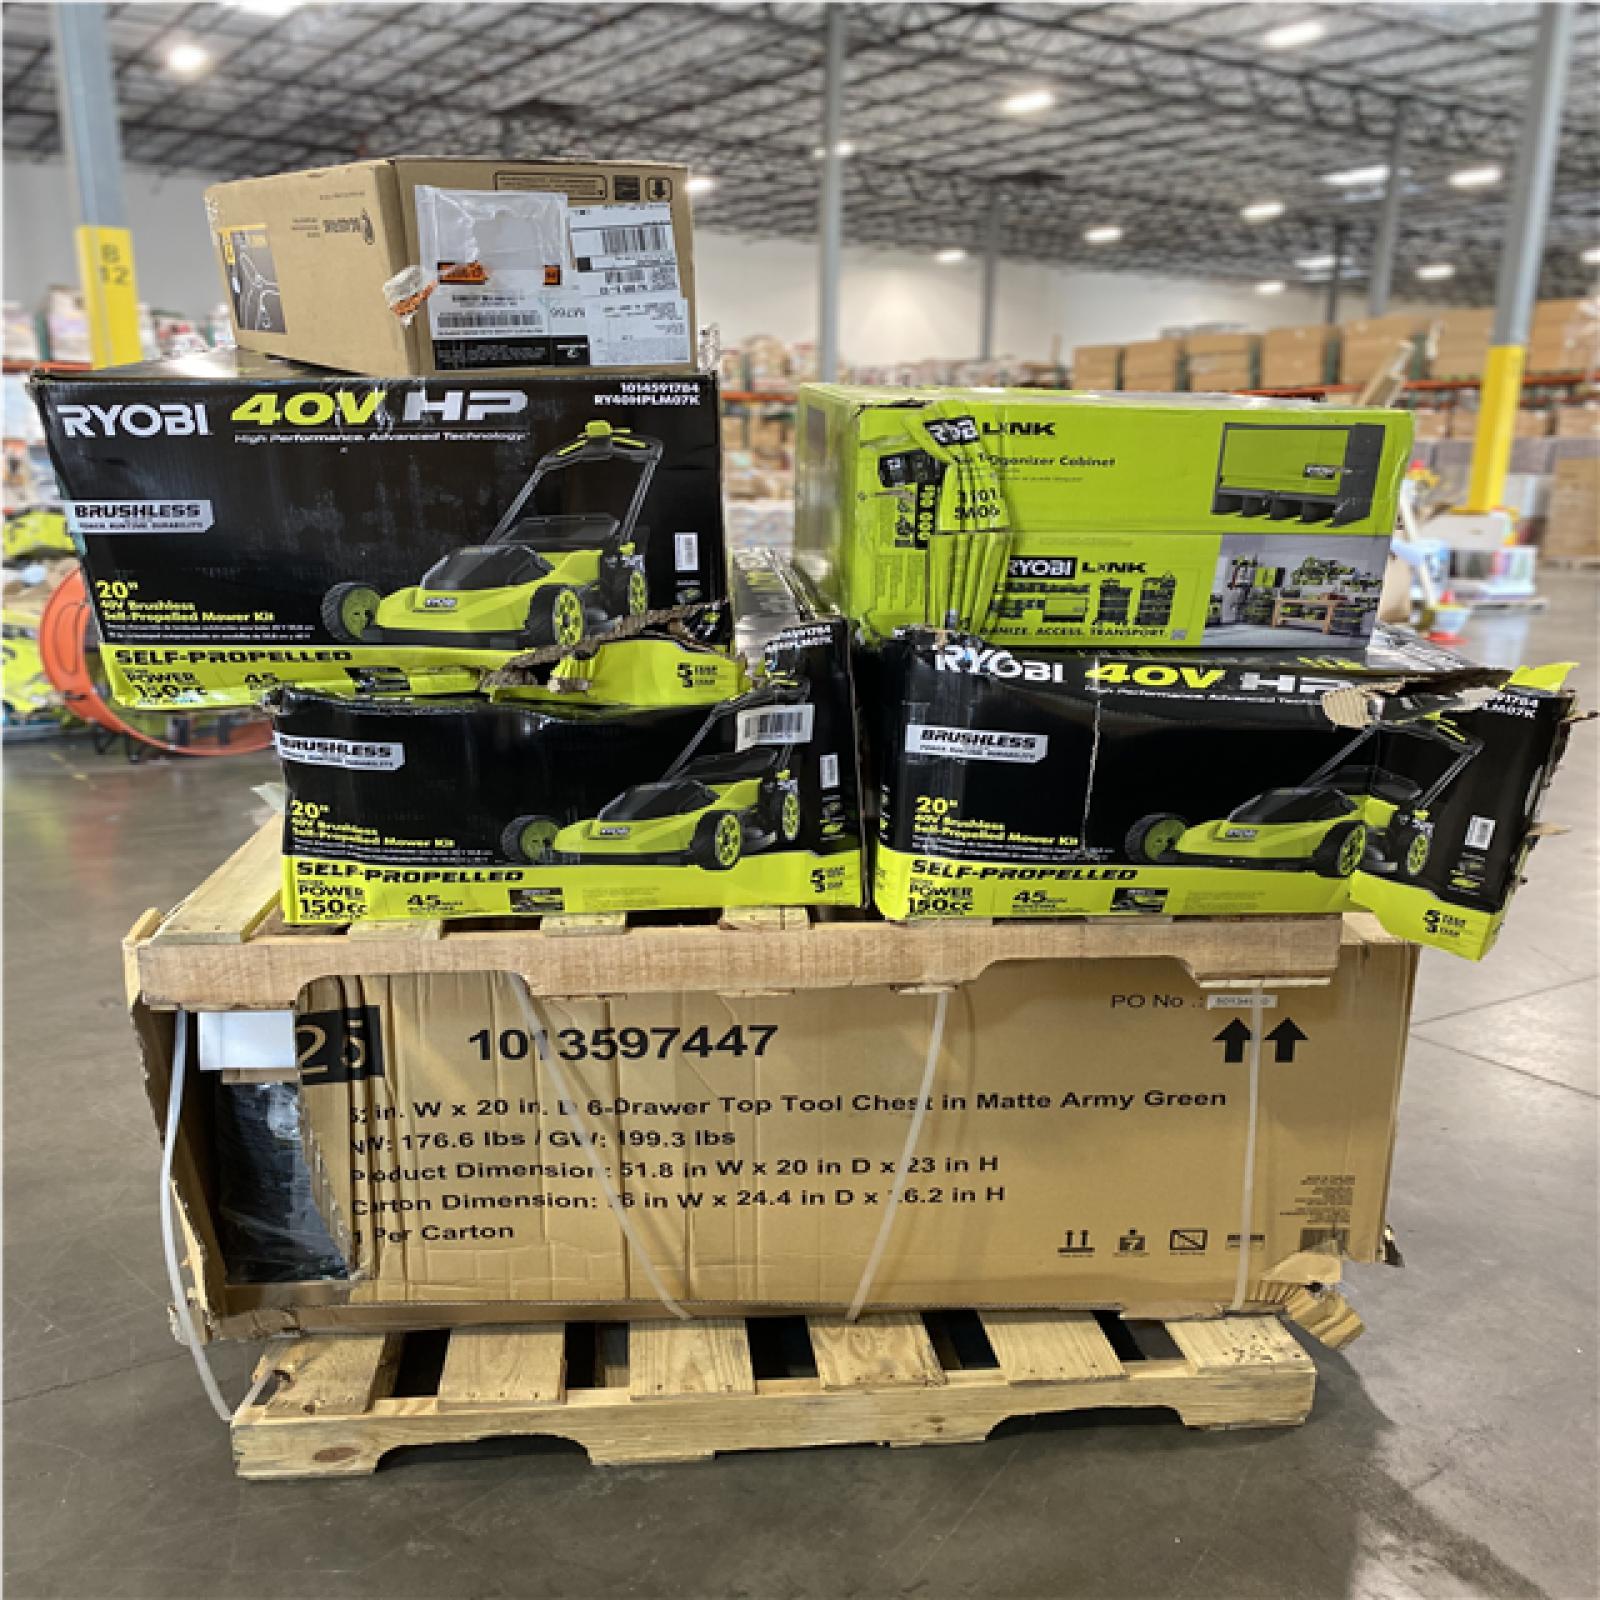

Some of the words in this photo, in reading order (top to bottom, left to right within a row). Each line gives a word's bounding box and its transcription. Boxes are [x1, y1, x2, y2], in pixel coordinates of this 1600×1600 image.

[100, 265, 129, 285] 12
[57, 403, 210, 437] RYOBI
[230, 391, 386, 427] 40V
[403, 389, 529, 421] HP
[1059, 454, 1117, 466] Cabinet
[74, 504, 200, 518] BRUSHLESS
[96, 580, 139, 599] 20"
[115, 650, 353, 665] SELF-PROPELLED
[934, 645, 1065, 683] RYOBI
[1085, 663, 1226, 689] 40V
[921, 729, 1036, 748] BRUSHLESS
[290, 799, 330, 818] 20"
[915, 796, 958, 815] 20"
[297, 861, 525, 884] SELF-PROPELLED
[911, 859, 1138, 880] SELF-PROPELLED
[299, 898, 368, 915] 150cc
[406, 894, 441, 907] 45
[909, 897, 973, 912] 150cc
[1111, 993, 1146, 1008] PO
[1152, 993, 1184, 1008] No
[467, 1024, 779, 1061] 1013597447
[412, 1100, 442, 1118] W
[475, 1098, 508, 1117] 20
[519, 1096, 548, 1117] in.
[587, 1097, 711, 1117] 6-Drawer
[717, 1096, 772, 1117] Top
[780, 1094, 843, 1113] Tool
[851, 1093, 934, 1113] Chest
[942, 1093, 967, 1111] in
[976, 1091, 1052, 1111] Matte
[1060, 1090, 1135, 1112] Army
[1144, 1089, 1228, 1108] Green
[403, 1130, 477, 1151] 176.6
[484, 1129, 528, 1148] lbs
[617, 1128, 688, 1149] 199.3
[694, 1128, 738, 1147] lbs
[620, 1161, 674, 1179] 51.8
[684, 1161, 709, 1179] in
[716, 1159, 744, 1177] W
[776, 1158, 809, 1177] 20
[816, 1158, 842, 1176] in
[851, 1157, 872, 1176] D
[944, 1154, 969, 1173] in
[979, 1154, 999, 1172] H
[441, 1191, 599, 1211] Dimension:
[644, 1190, 670, 1210] in
[677, 1190, 705, 1209] W
[736, 1189, 792, 1207] 24.4
[801, 1188, 827, 1206] in
[834, 1187, 855, 1206] D
[887, 1187, 943, 1204] 6.2
[952, 1186, 977, 1204] in
[984, 1185, 1006, 1203] H
[420, 1221, 516, 1242] Carton
